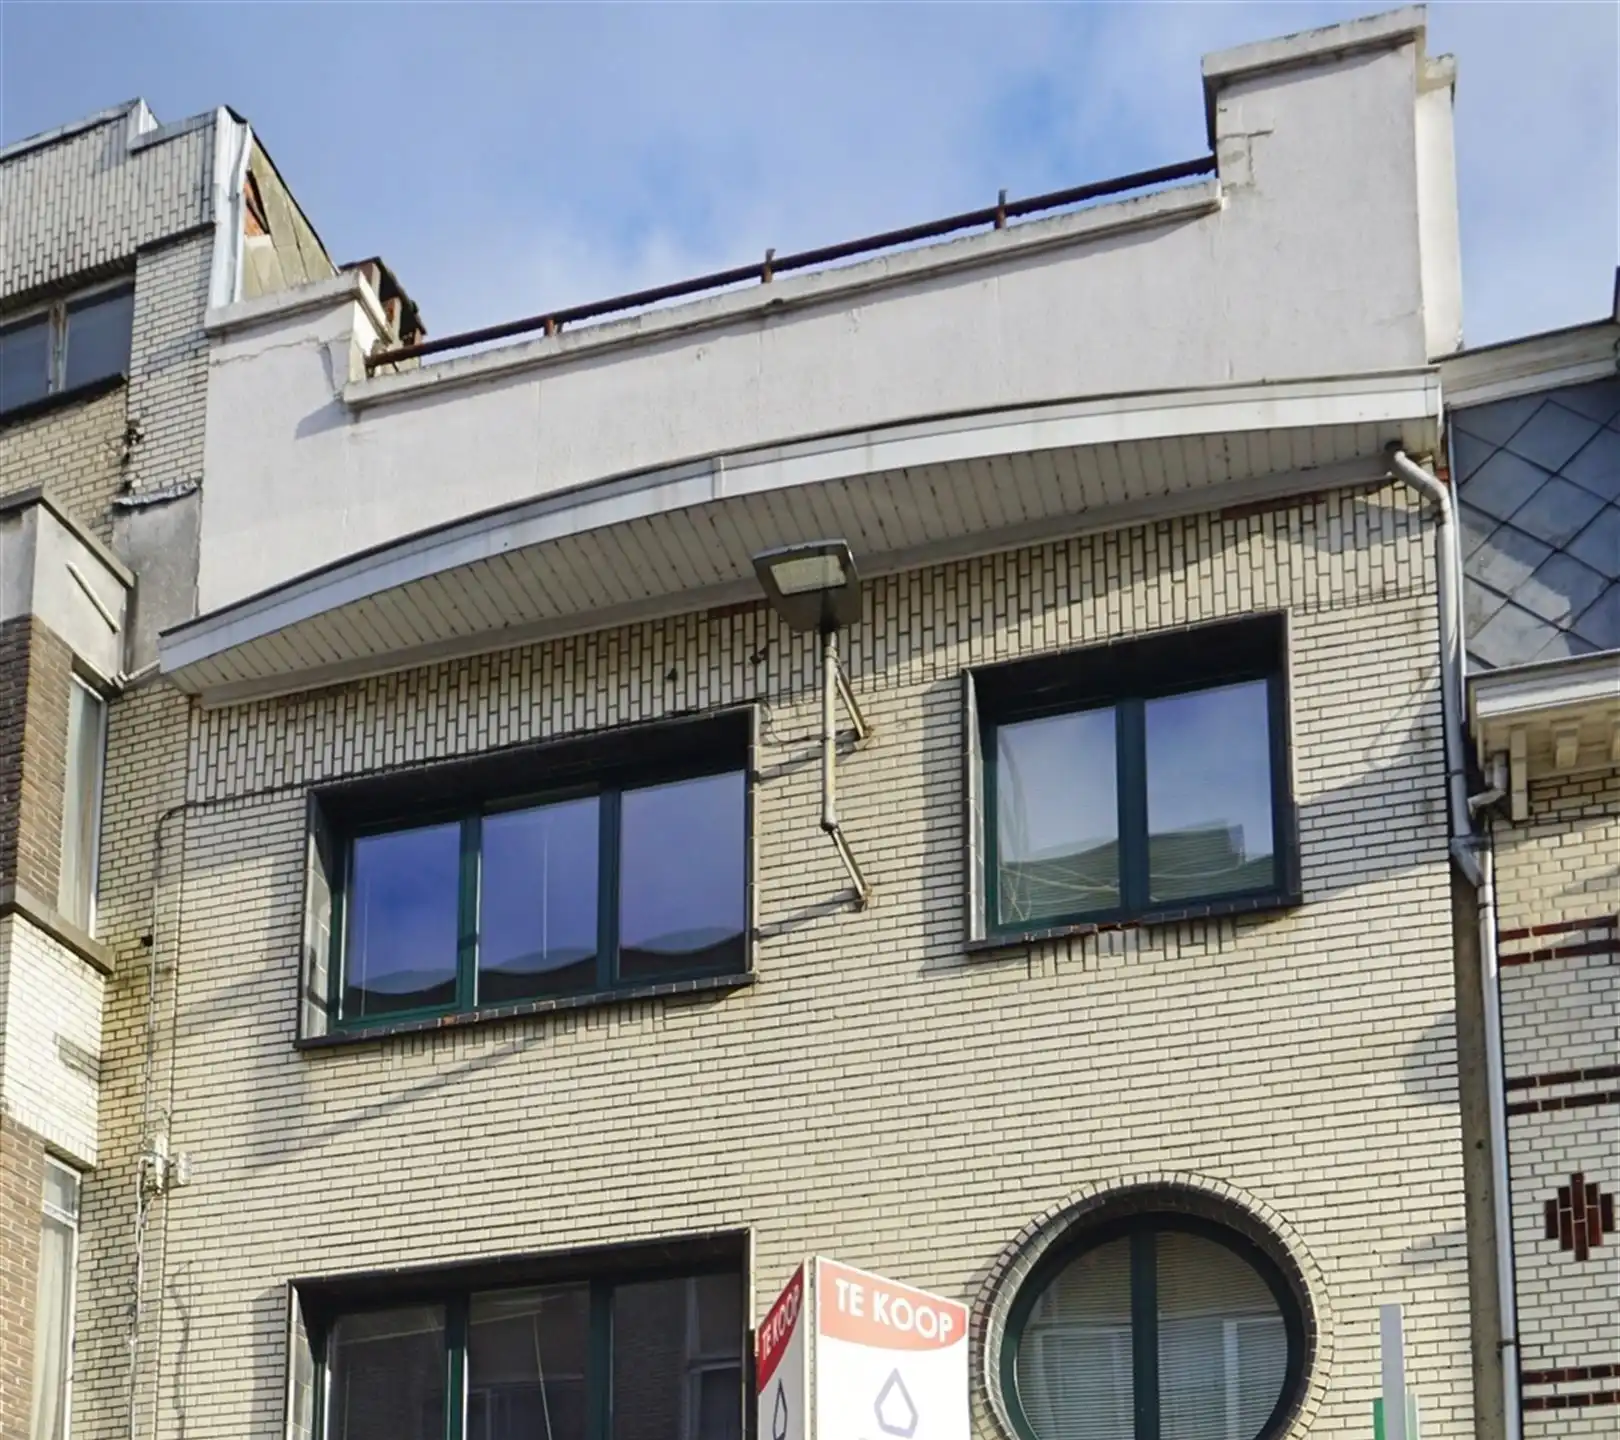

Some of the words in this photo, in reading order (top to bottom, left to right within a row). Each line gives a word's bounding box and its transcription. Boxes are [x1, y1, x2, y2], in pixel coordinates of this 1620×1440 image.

[762, 1323, 772, 1360] TE
[773, 1284, 799, 1347] KOOP
[835, 1278, 864, 1317] TE
[873, 1290, 953, 1343] KOOP
